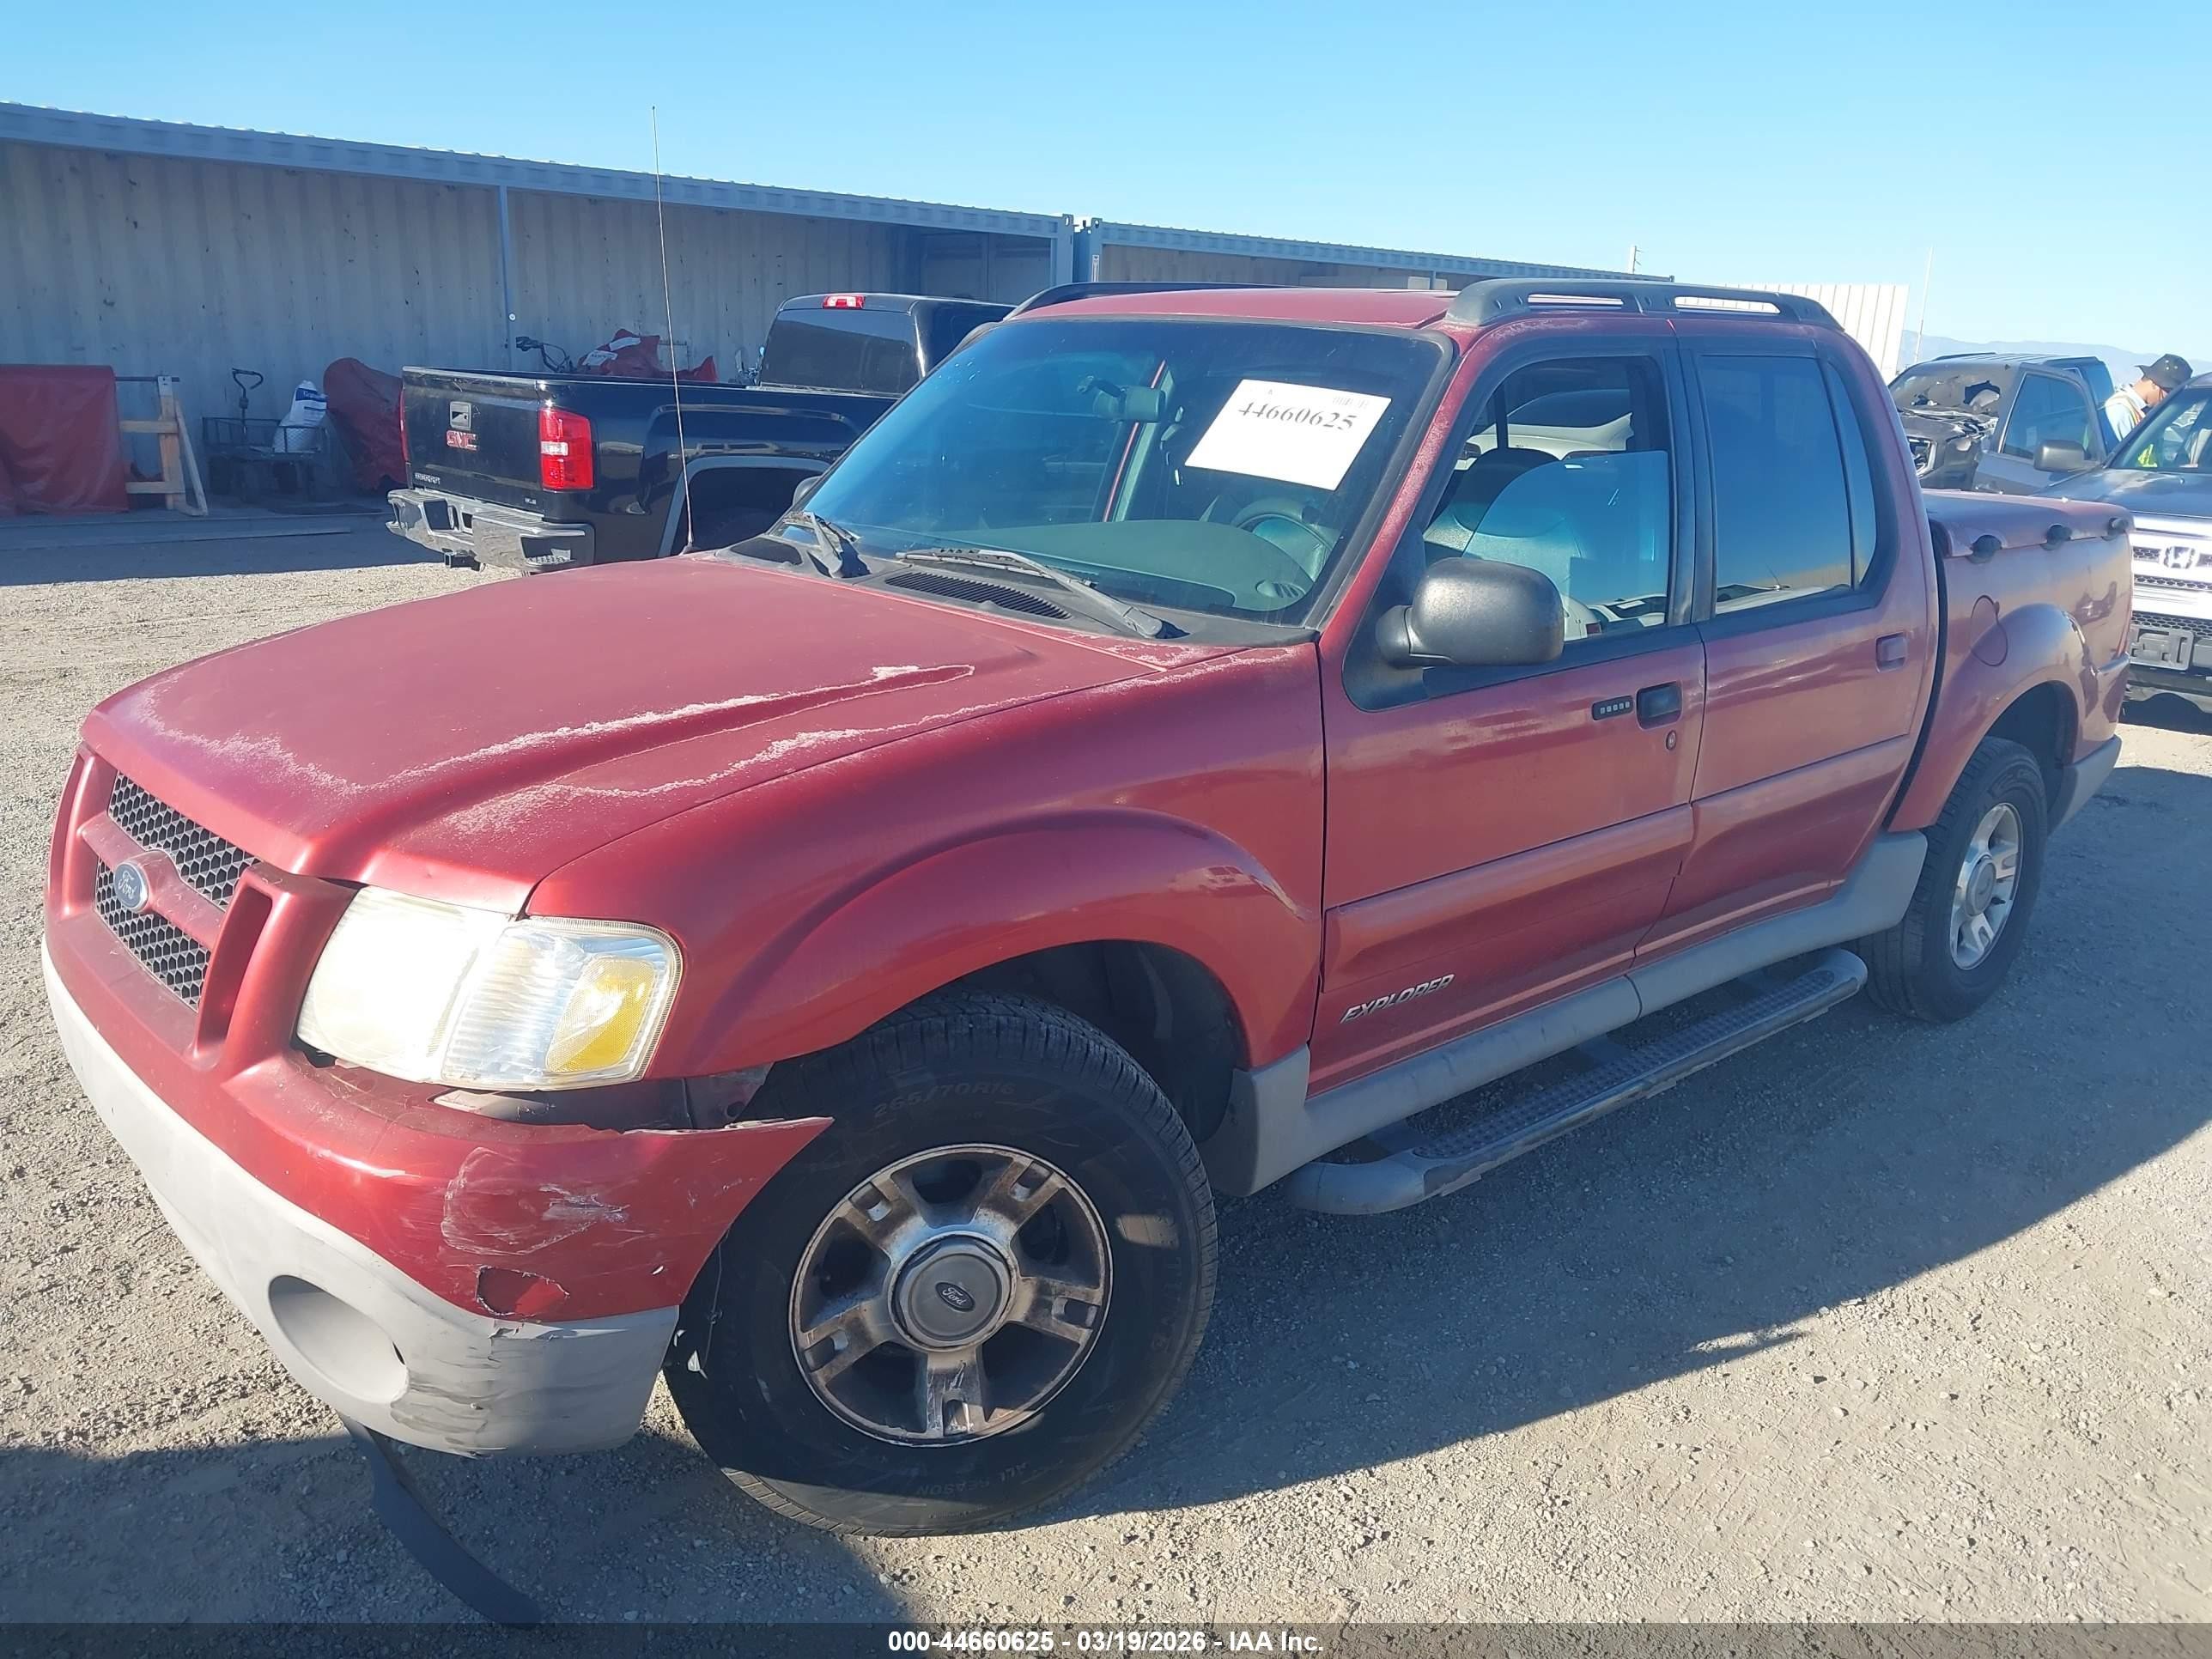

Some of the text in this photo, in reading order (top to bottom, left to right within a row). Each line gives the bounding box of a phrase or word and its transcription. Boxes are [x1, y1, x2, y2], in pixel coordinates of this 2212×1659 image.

[1238, 401, 1358, 431] 44660625
[1340, 973, 1455, 1024] EXPLORER
[942, 1287, 968, 1305] Ford
